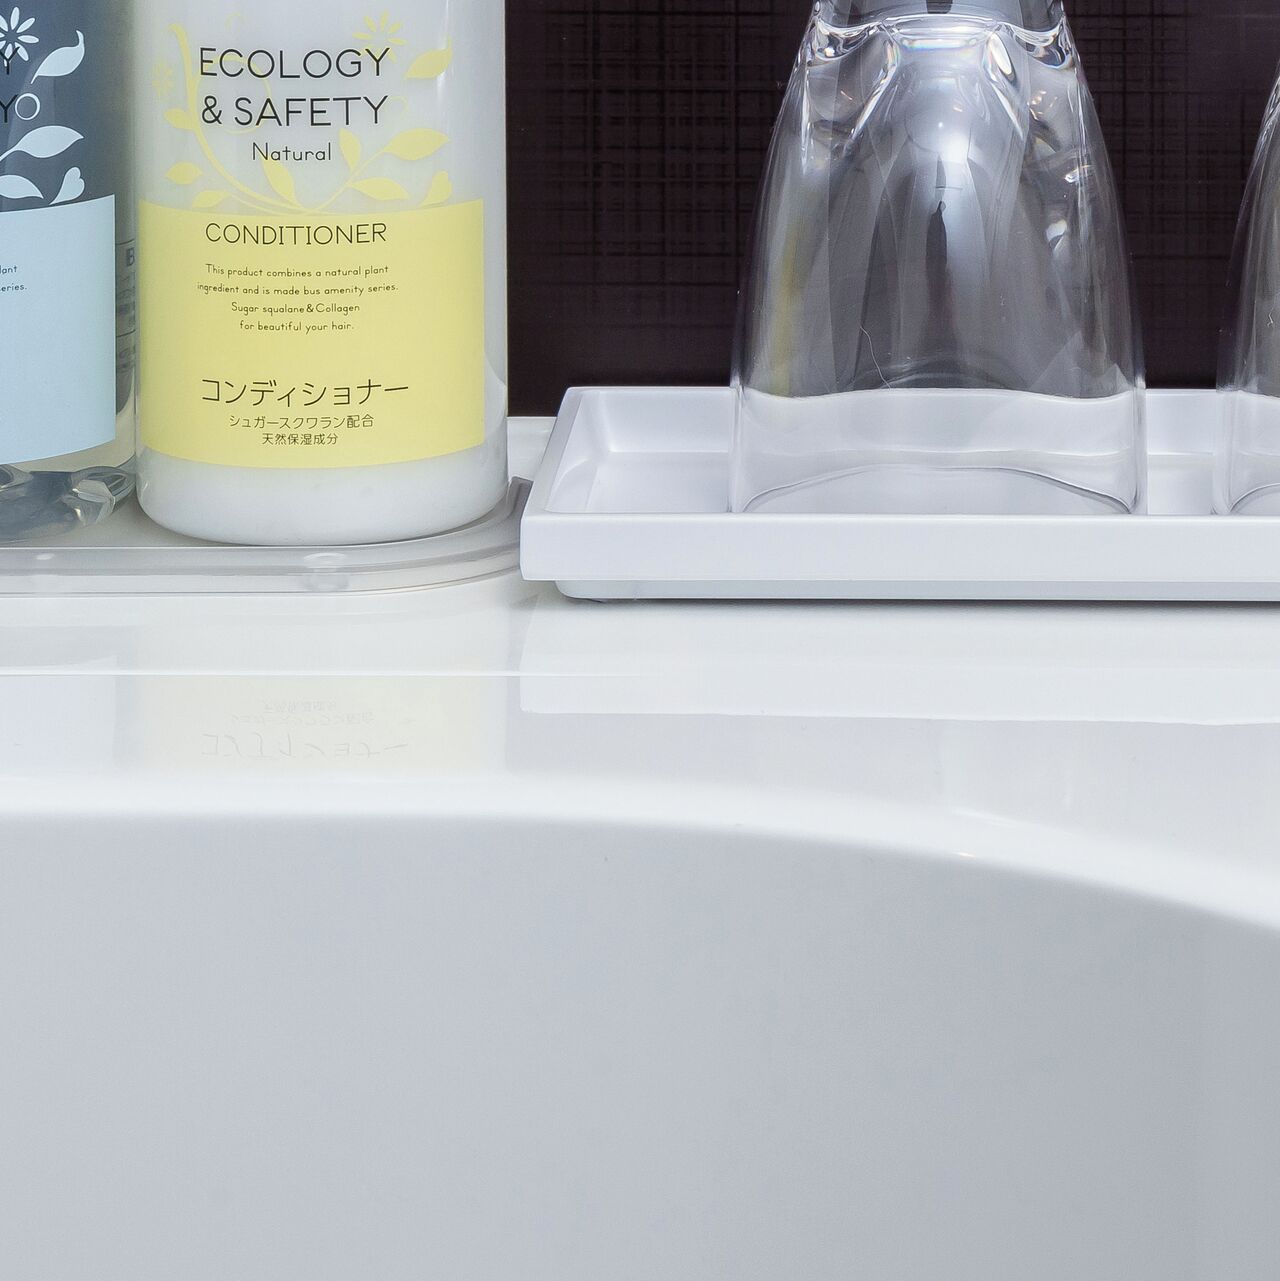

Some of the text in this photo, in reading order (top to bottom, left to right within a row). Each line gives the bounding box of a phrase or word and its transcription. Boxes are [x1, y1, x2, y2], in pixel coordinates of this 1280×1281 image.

[200, 47, 390, 78] ECOLOGY
[202, 95, 388, 126] & SAFETY
[252, 142, 331, 161] Natural
[206, 223, 387, 245] CONDITIONER
[205, 263, 224, 275] This
[228, 268, 263, 279] product
[267, 269, 311, 277] combines
[325, 266, 361, 276] natural
[365, 266, 388, 278] plant
[197, 282, 398, 296] ingredient and is made bus amenity series.
[231, 302, 259, 316] Sugar
[240, 320, 354, 335] for beautiful your hair.
[202, 379, 408, 407] コンディショナー
[229, 414, 374, 429] シュガースクワラン配合
[262, 433, 338, 445] 天然保湿成分
